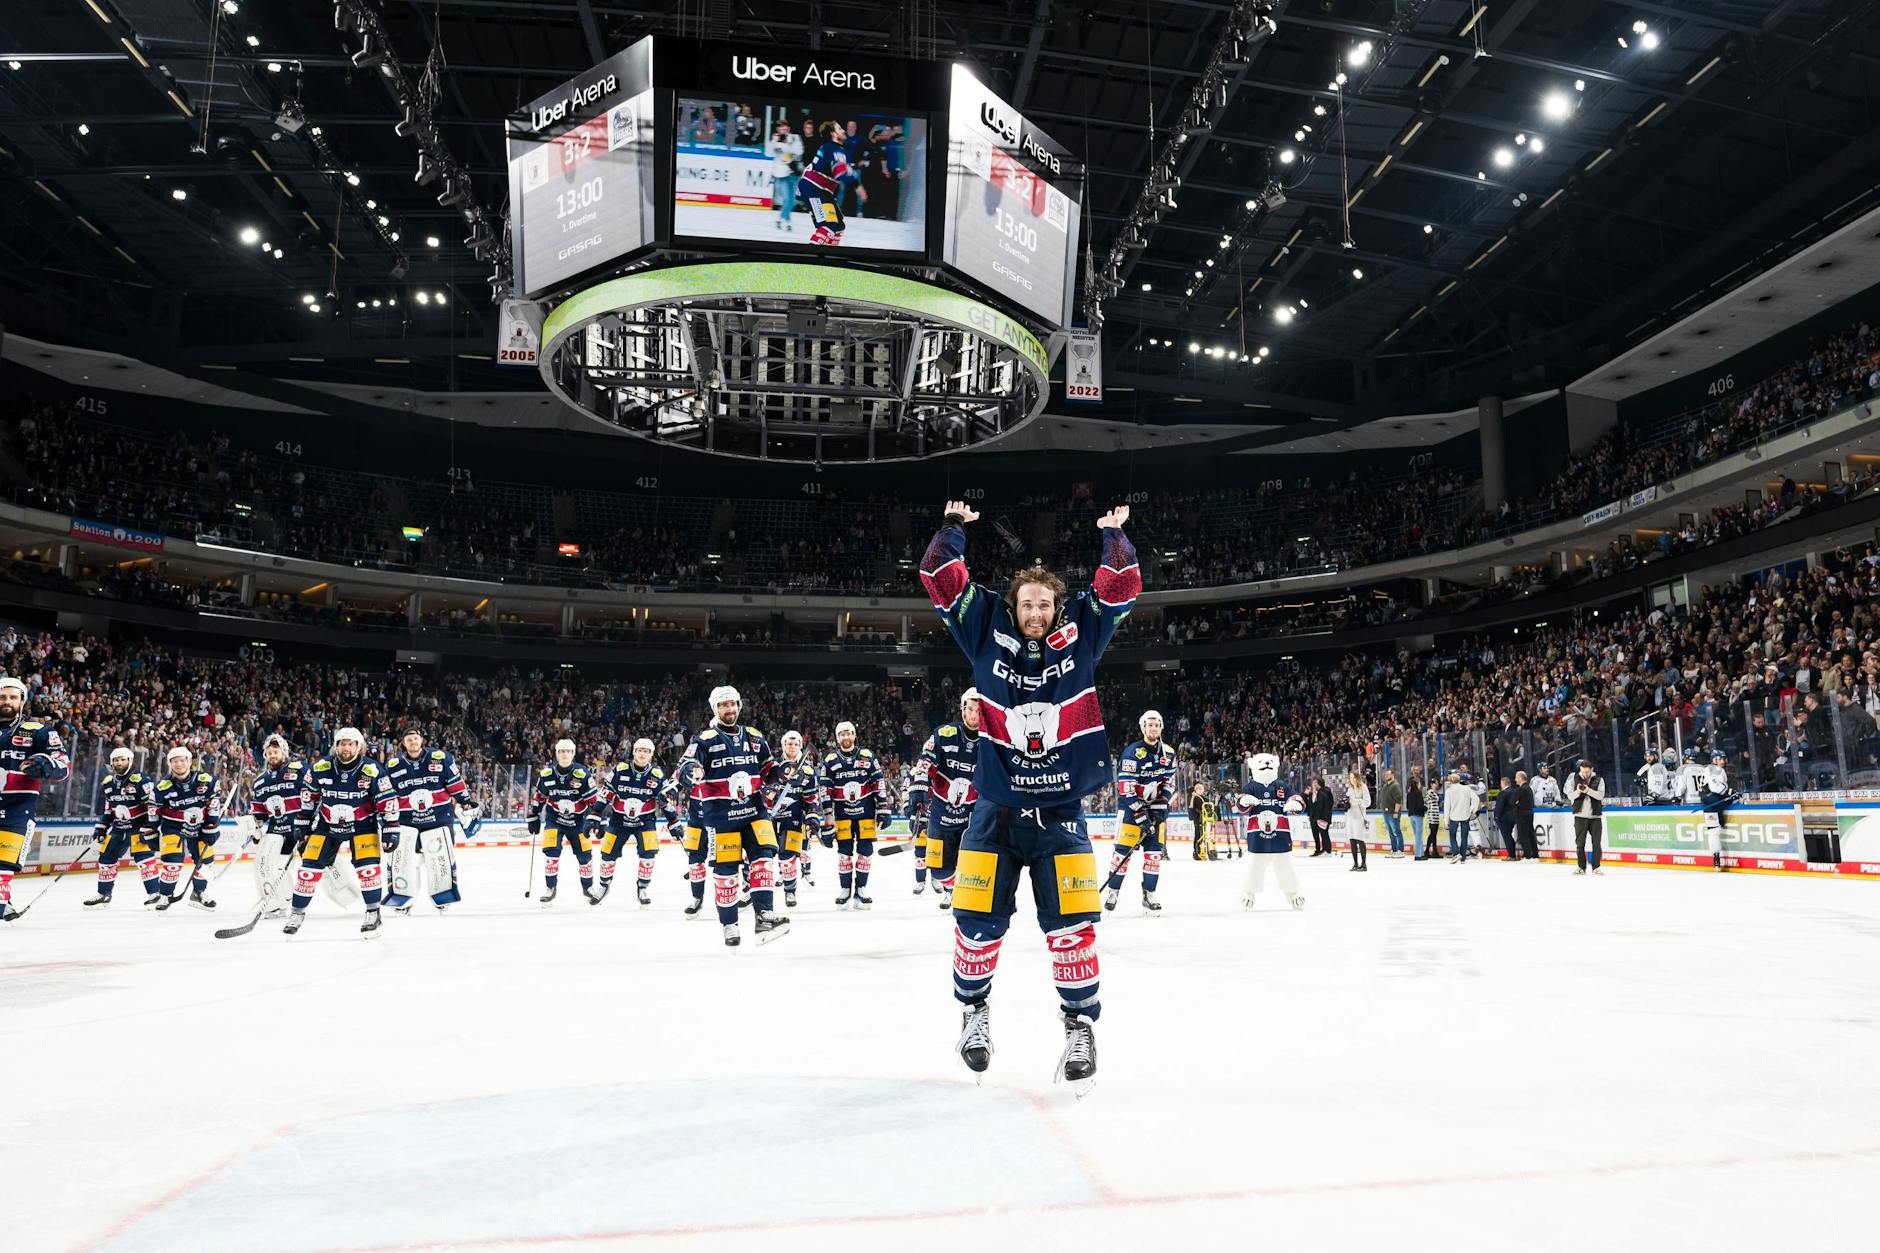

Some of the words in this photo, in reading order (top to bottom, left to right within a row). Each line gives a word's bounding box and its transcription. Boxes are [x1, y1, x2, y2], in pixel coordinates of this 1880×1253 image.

[732, 56, 796, 82] Uber
[802, 62, 876, 90] Arena
[531, 99, 568, 131] Uber
[571, 74, 616, 111] Arena
[564, 131, 591, 166] 3:2
[1022, 132, 1062, 175] Arena
[556, 176, 603, 219] 13:00
[569, 211, 597, 229] Overtime
[994, 208, 1038, 252] 13:00
[558, 234, 602, 260] GASAG
[992, 260, 1033, 291] GASAG
[968, 306, 999, 334] GET
[501, 350, 535, 361] 2005
[1069, 385, 1099, 396] 2022
[1708, 374, 1735, 398] 406
[76, 396, 108, 414] 415
[275, 441, 303, 456] 414
[447, 467, 472, 480] 413
[636, 477, 658, 489] 412
[802, 482, 821, 495] 411
[964, 488, 984, 499] 410
[1125, 491, 1149, 504] 409
[992, 655, 1075, 691] GASAG
[743, 741, 750, 752] A
[1011, 752, 1060, 769] BERLIN
[398, 775, 440, 789] GASAG
[727, 806, 758, 817] structure
[1672, 856, 1696, 864] PENNY.
[1757, 859, 1784, 869] PENNY.
